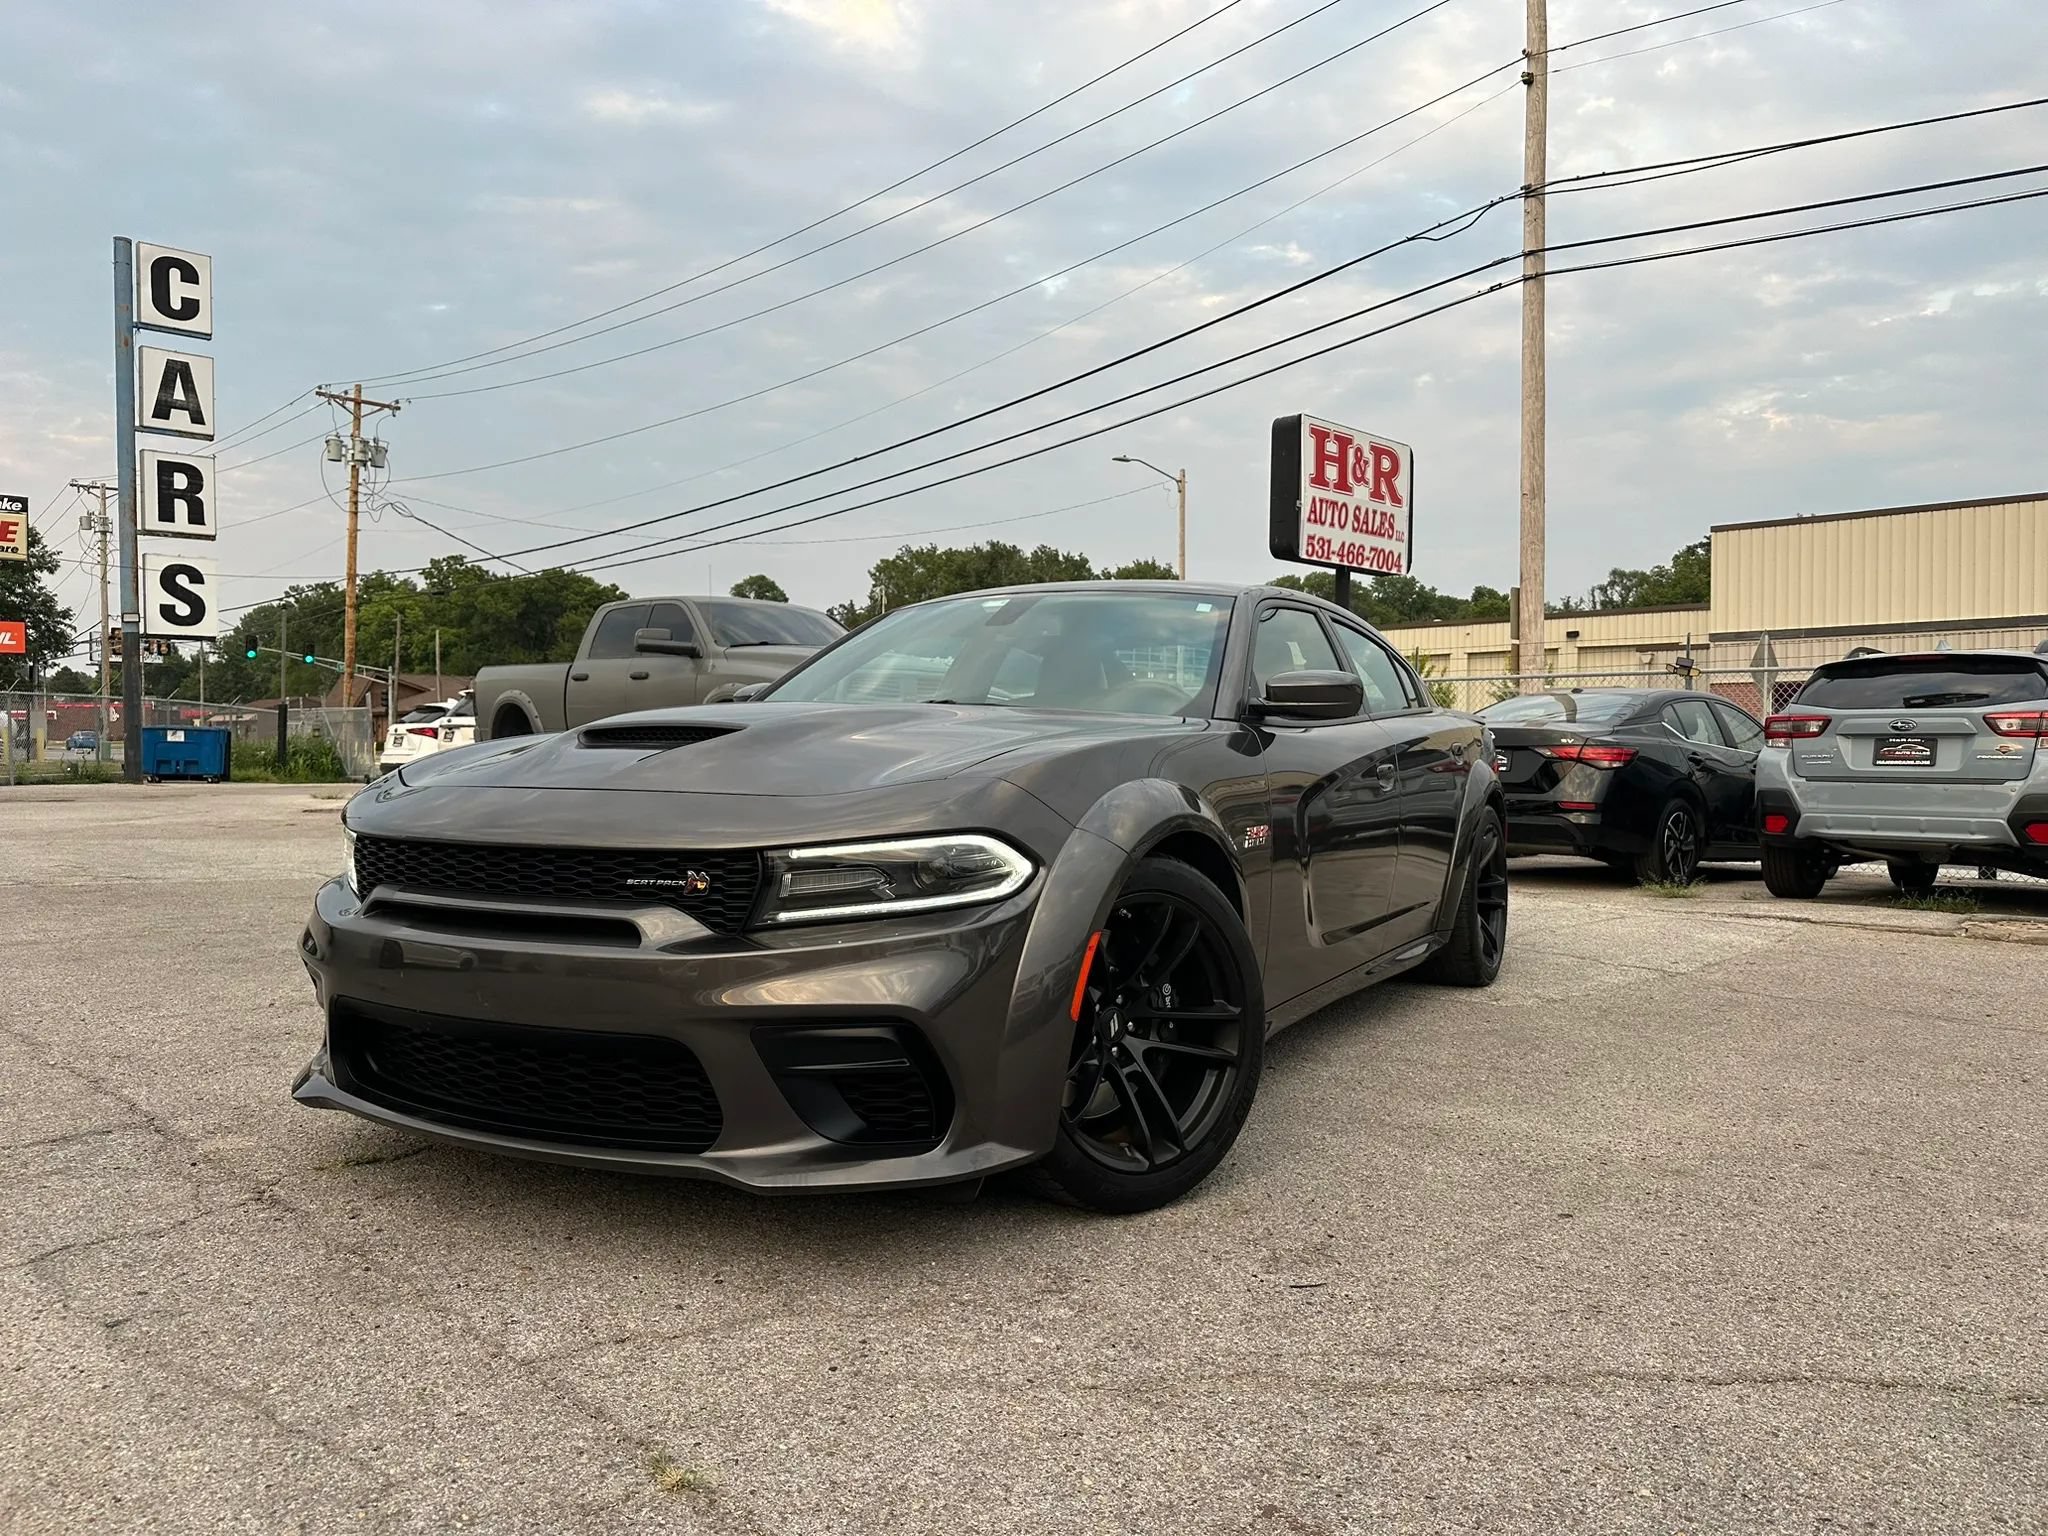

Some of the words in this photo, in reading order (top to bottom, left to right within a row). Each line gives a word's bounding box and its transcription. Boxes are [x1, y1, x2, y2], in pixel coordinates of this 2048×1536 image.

[150, 255, 207, 628] CARS
[1309, 423, 1403, 508] H&R
[0, 498, 23, 511] ke
[1307, 496, 1348, 530] AUTO
[1352, 504, 1395, 540] SALES
[1306, 533, 1403, 573] 531-466-7004
